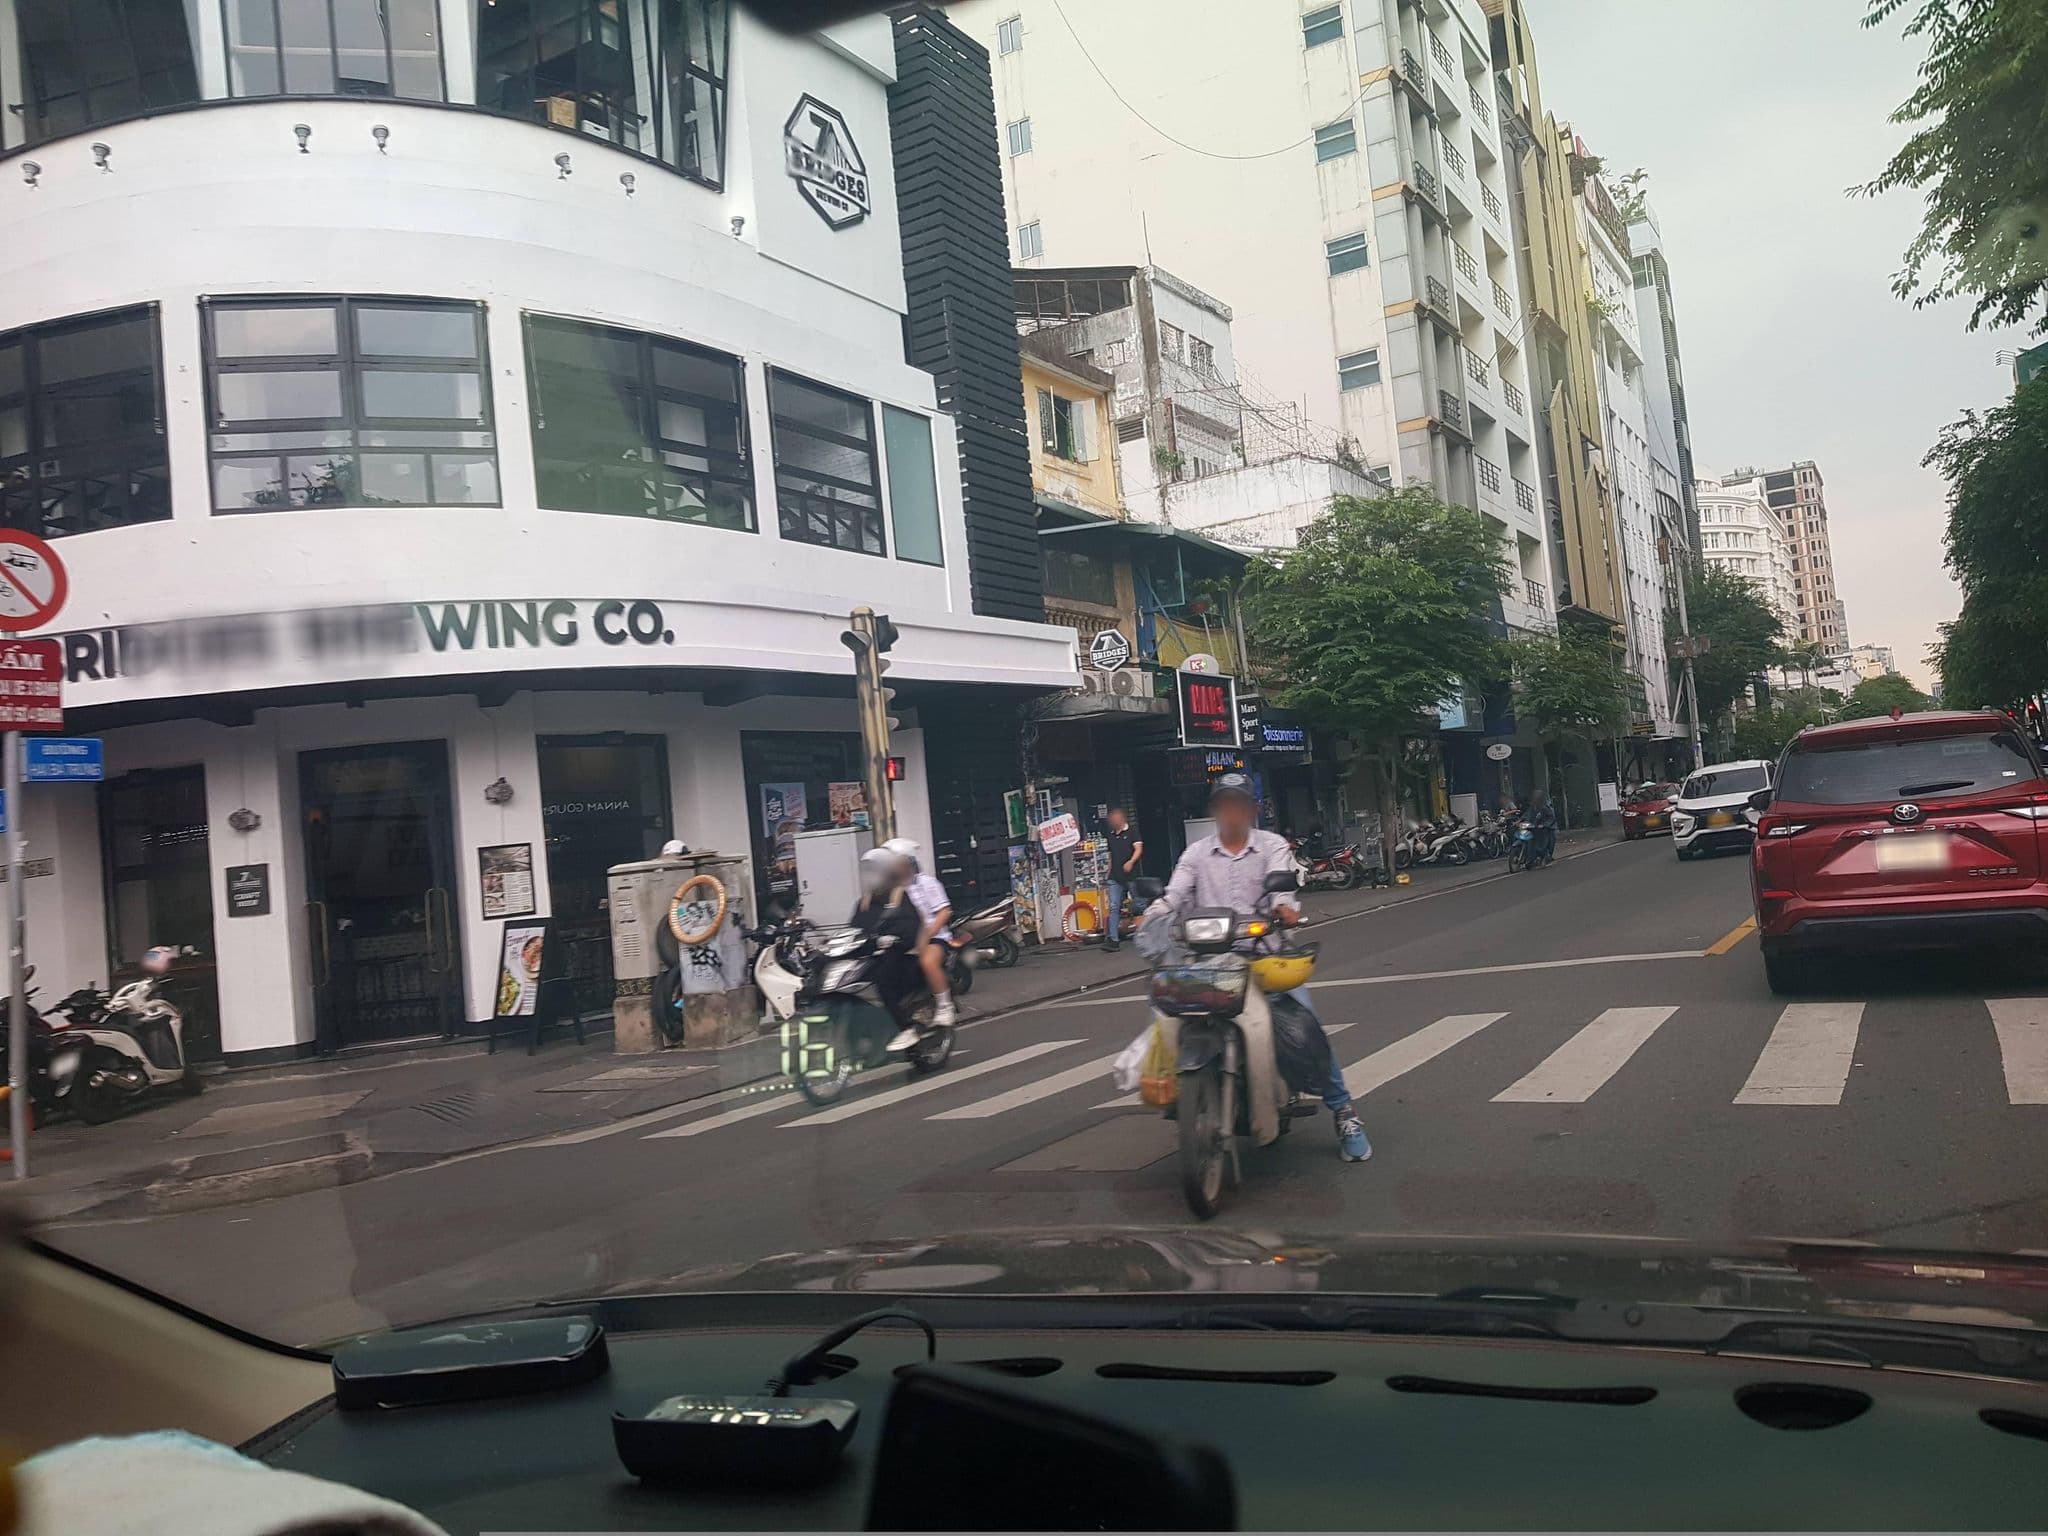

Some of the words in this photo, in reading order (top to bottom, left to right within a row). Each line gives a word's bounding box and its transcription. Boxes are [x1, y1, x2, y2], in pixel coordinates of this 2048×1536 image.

[594, 599, 674, 645] CO.
[1092, 646, 1127, 661] BRIDGES
[1240, 703, 1257, 714] Mars
[1241, 717, 1259, 729] Sport
[1243, 732, 1255, 742] Bar
